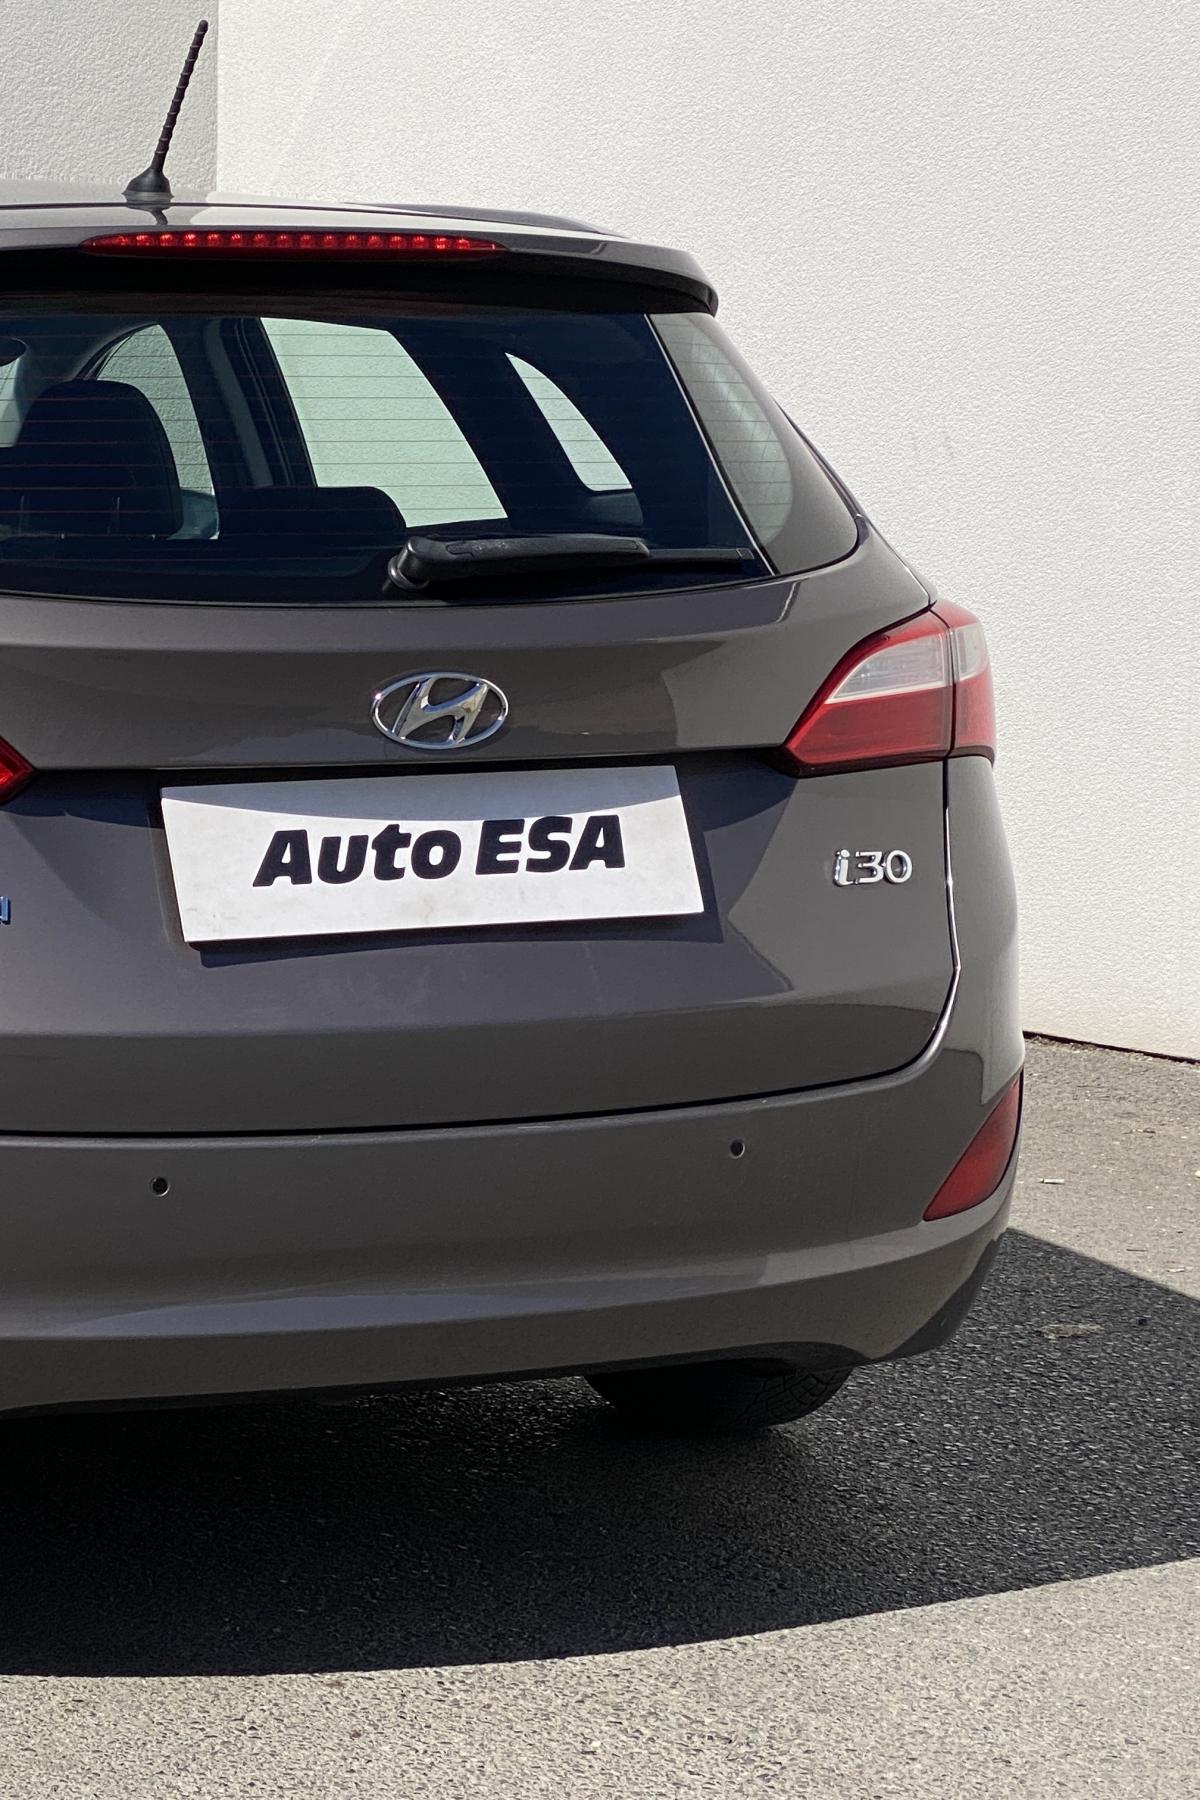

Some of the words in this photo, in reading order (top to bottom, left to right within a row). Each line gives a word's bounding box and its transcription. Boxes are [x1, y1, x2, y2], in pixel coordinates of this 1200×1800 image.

[253, 824, 462, 887] Auto
[475, 815, 625, 875] ESA
[833, 849, 913, 886] i30
